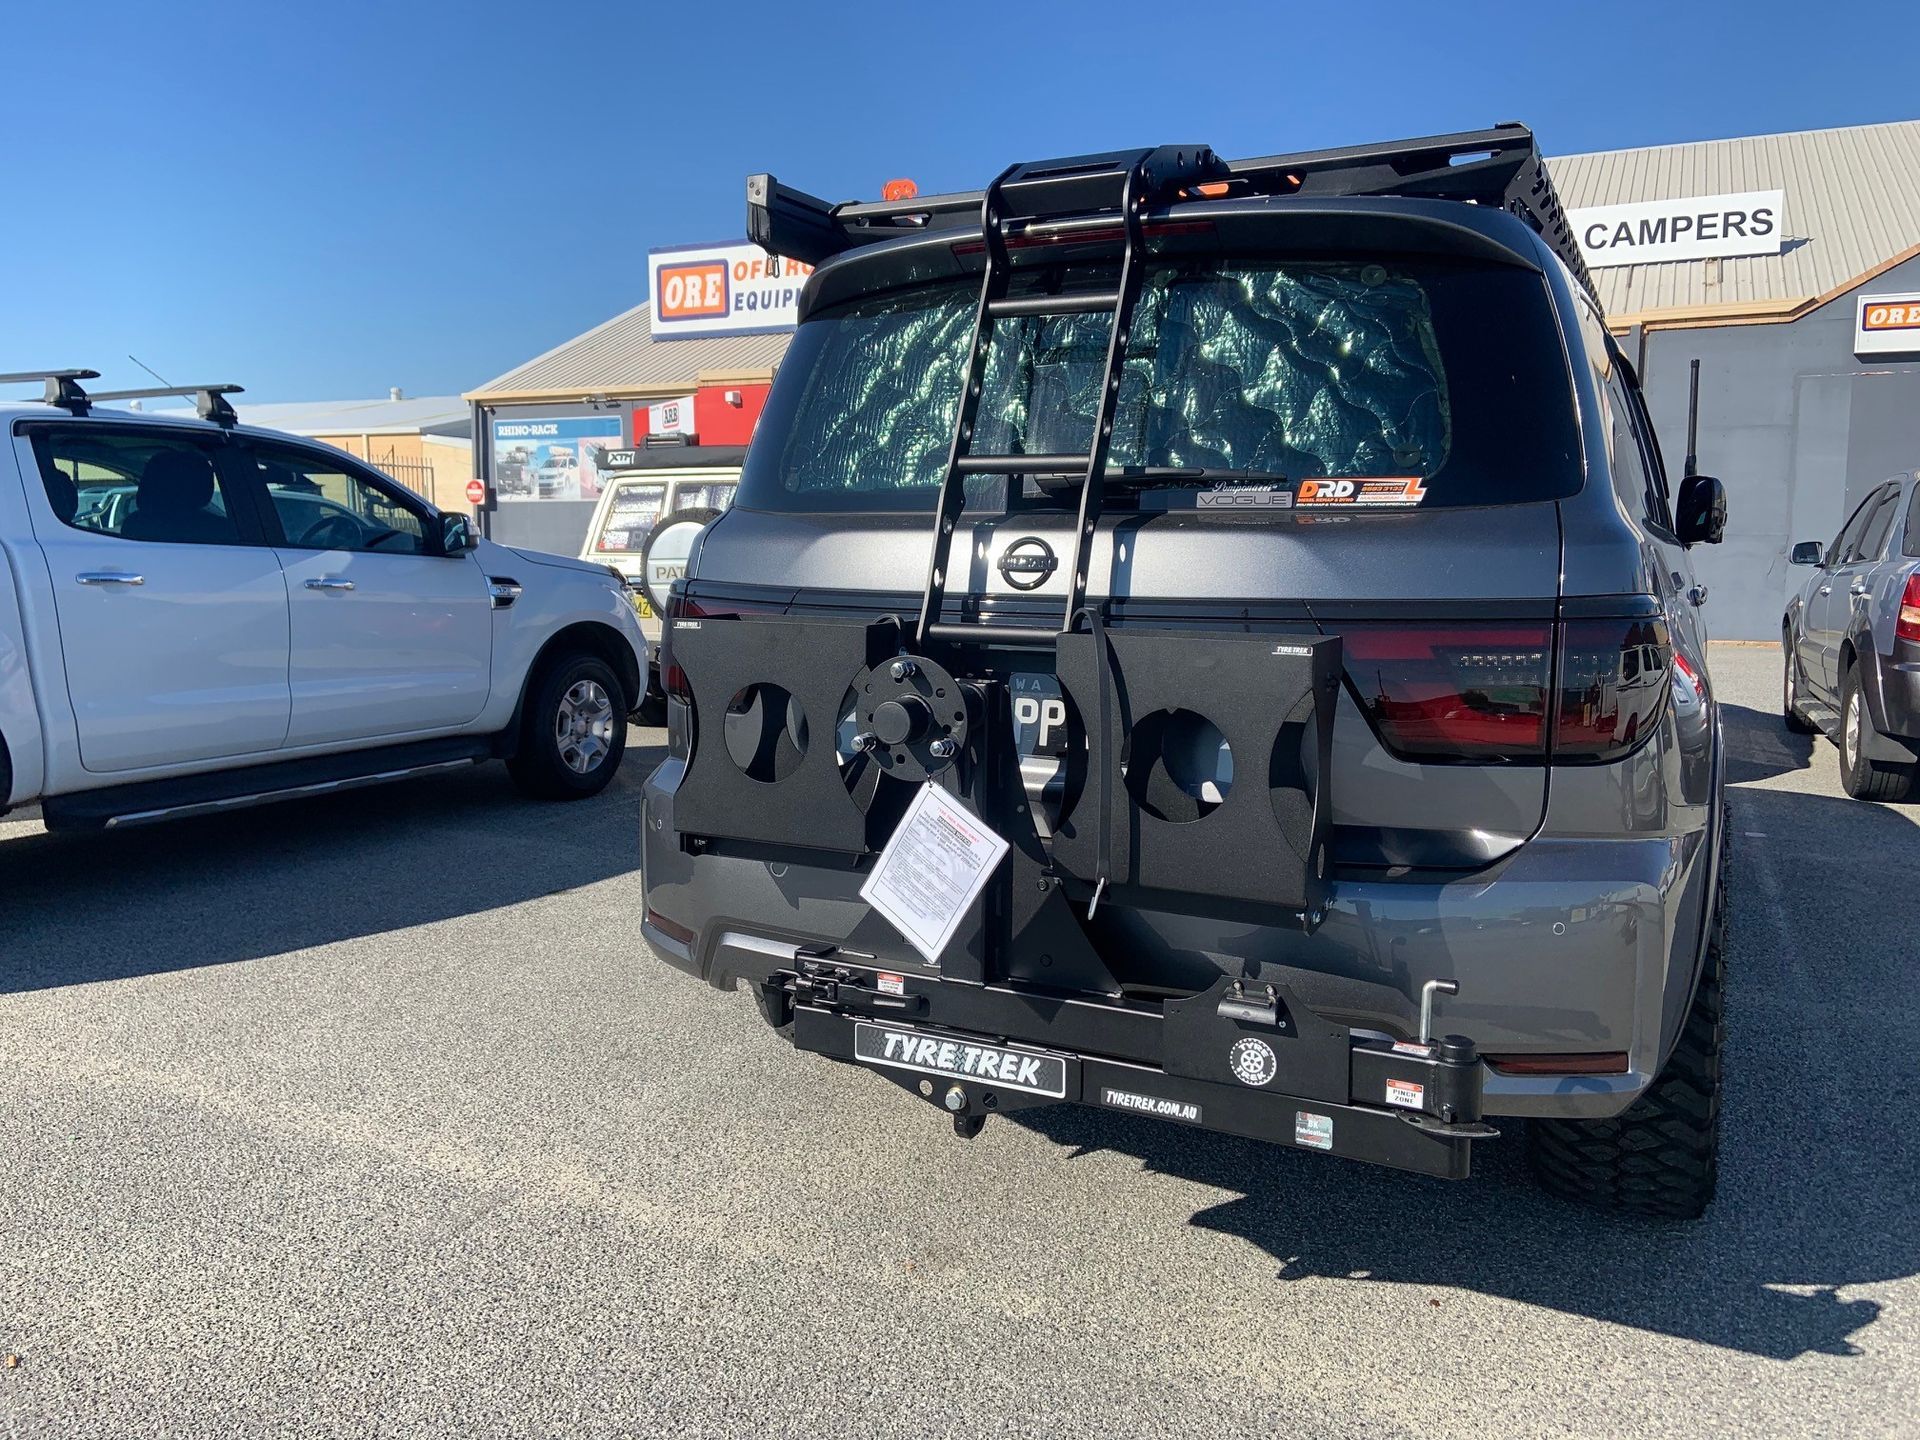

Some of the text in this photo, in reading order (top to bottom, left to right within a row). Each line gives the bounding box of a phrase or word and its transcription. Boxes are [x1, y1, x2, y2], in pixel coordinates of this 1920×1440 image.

[1585, 208, 1773, 249] CAMPERS
[665, 273, 722, 310] ORE
[1869, 306, 1920, 325] ORE
[664, 407, 678, 424] ARB
[498, 424, 558, 436] RHINO-RACK
[608, 453, 633, 465] XTM
[1299, 481, 1354, 498] DRD
[1199, 495, 1287, 505] VOGUE
[656, 566, 685, 579] PAT
[1292, 646, 1308, 654] TREK
[1015, 697, 1066, 747] PP
[1238, 1041, 1269, 1058] TYRE
[884, 1033, 1041, 1086] TYRE TREK
[1236, 1064, 1267, 1081] TREK
[1392, 1088, 1416, 1098] PINCH
[1394, 1095, 1414, 1104] ZONE
[1106, 1089, 1198, 1120] TYRETREK.COM.AU
[1308, 1119, 1319, 1129] BK
